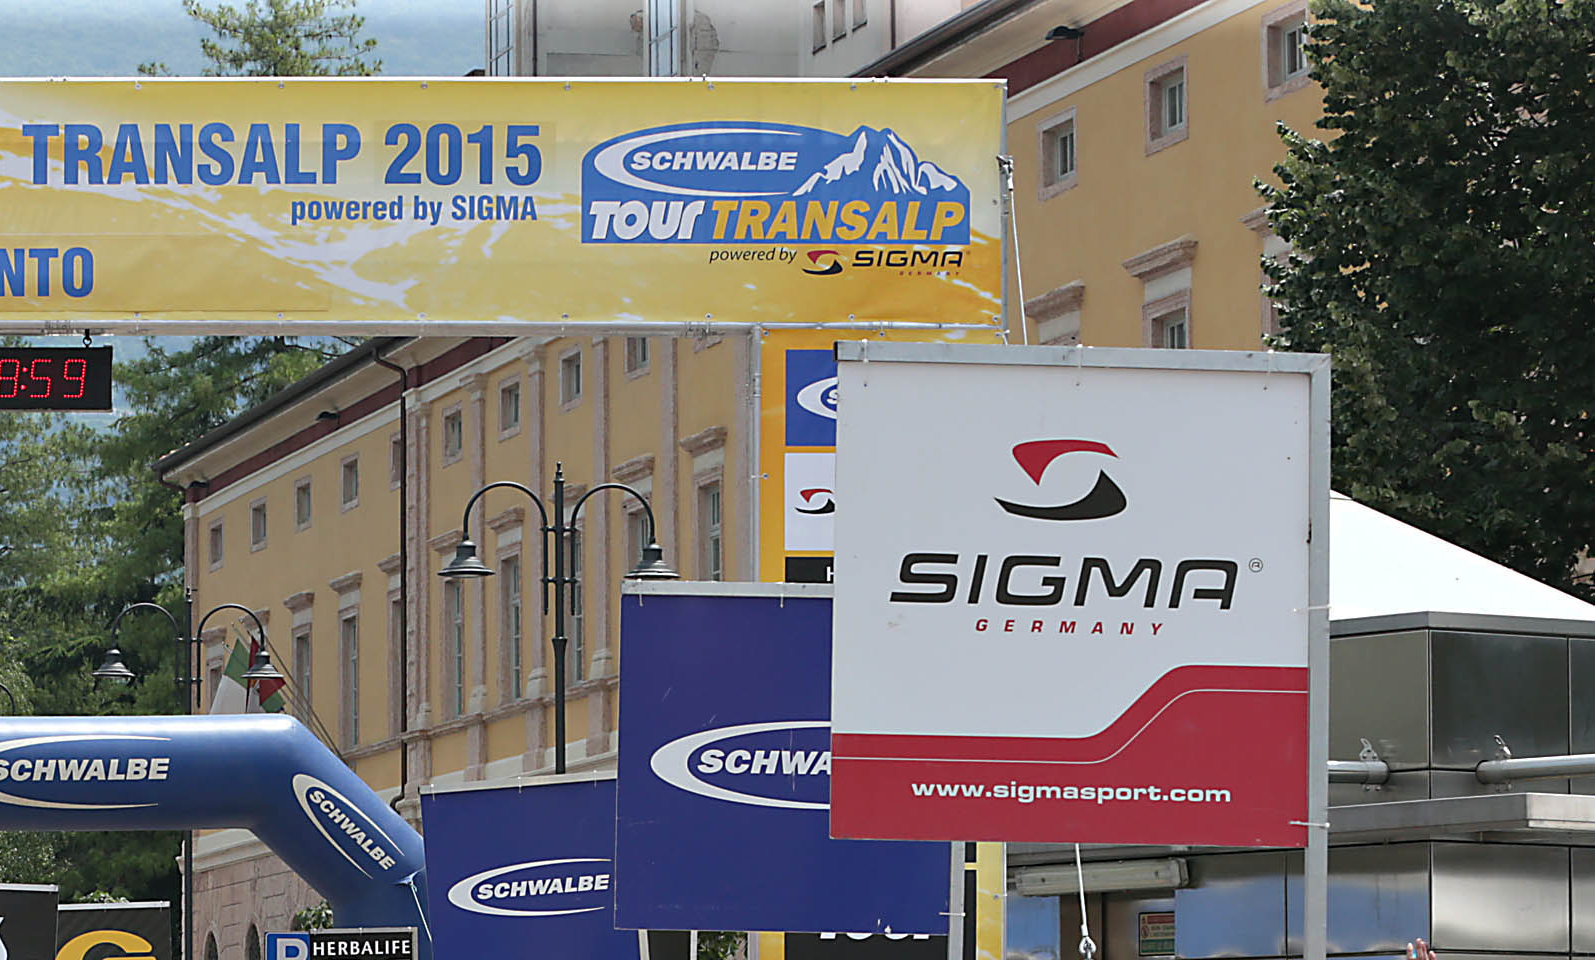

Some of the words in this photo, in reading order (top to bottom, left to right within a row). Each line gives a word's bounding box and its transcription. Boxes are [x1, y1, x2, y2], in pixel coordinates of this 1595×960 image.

[22, 123, 361, 185] TRANSALP
[384, 123, 543, 185] 2015
[630, 151, 798, 171] SCHWALBE
[290, 195, 403, 226] powered
[413, 195, 442, 226] by
[451, 195, 538, 222] SIGMA
[711, 201, 965, 241] TRANSALP
[709, 247, 776, 264] powered
[779, 247, 798, 264] by
[852, 250, 964, 268] SIGMA
[889, 553, 1238, 610] SIGMA
[975, 619, 1163, 636] GERMANY
[911, 781, 1231, 804] www.sigmasport.com
[309, 790, 395, 870] SCHWALBE
[477, 874, 610, 900] SCHWALBE
[313, 940, 411, 956] HERBALIFE
